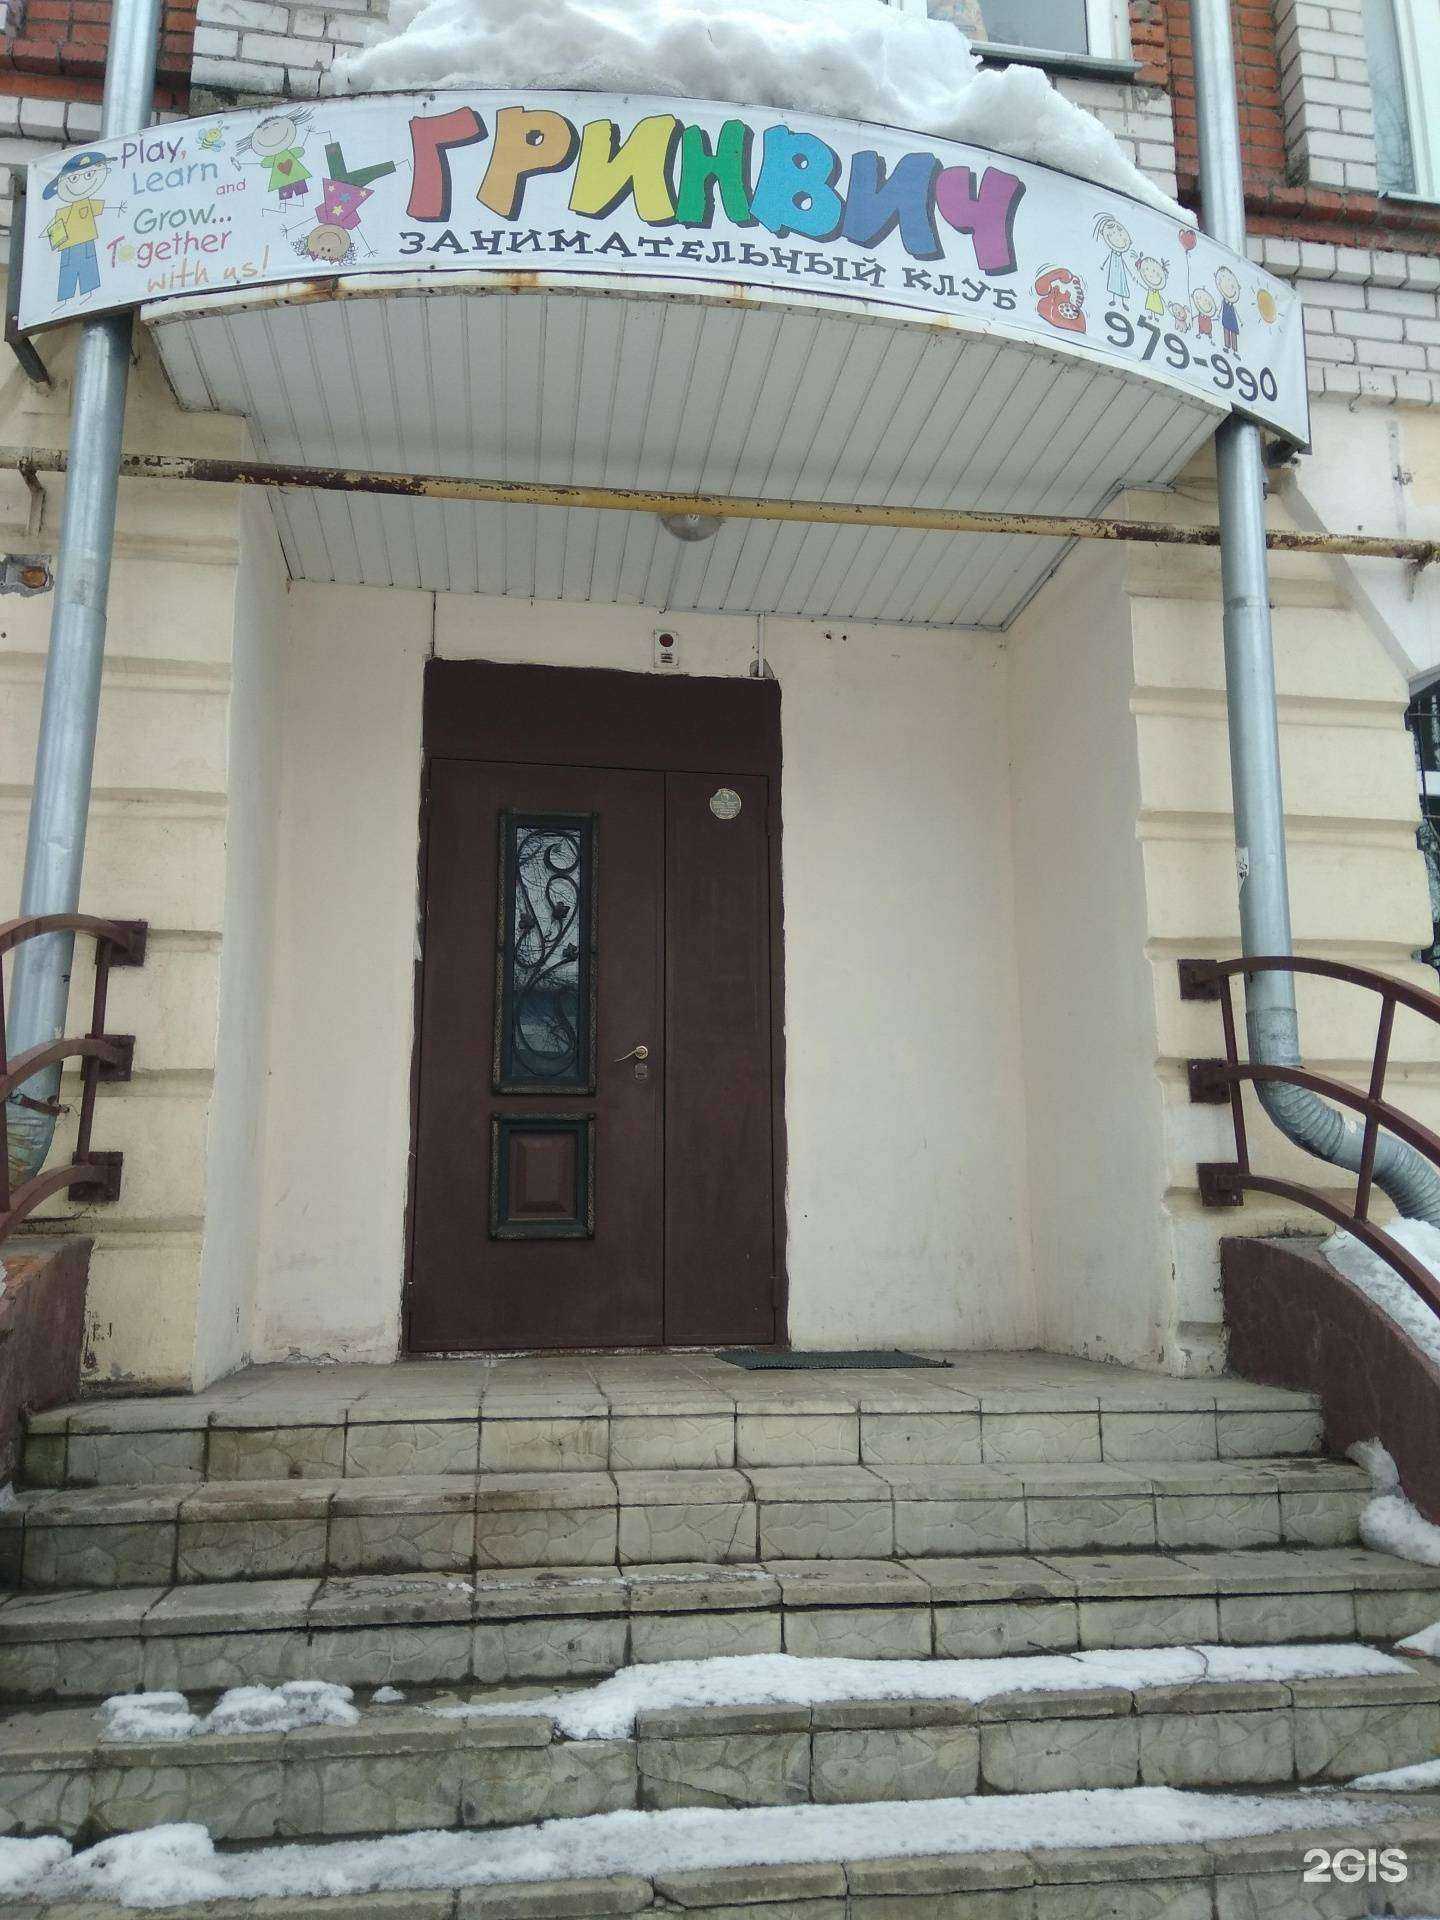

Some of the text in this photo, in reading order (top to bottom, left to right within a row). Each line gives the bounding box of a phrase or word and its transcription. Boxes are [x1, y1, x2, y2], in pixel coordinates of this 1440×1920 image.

[133, 160, 218, 195] Learn
[216, 179, 246, 196] and
[406, 106, 1025, 275] ГРИНВИЧ
[134, 203, 232, 234] Grow...
[107, 230, 232, 269] Together
[147, 245, 270, 292] with us!
[399, 229, 1017, 310] ЗАНИМАТЕЛЬНЫЙ КЛУБ
[1104, 311, 1277, 401] 979-990
